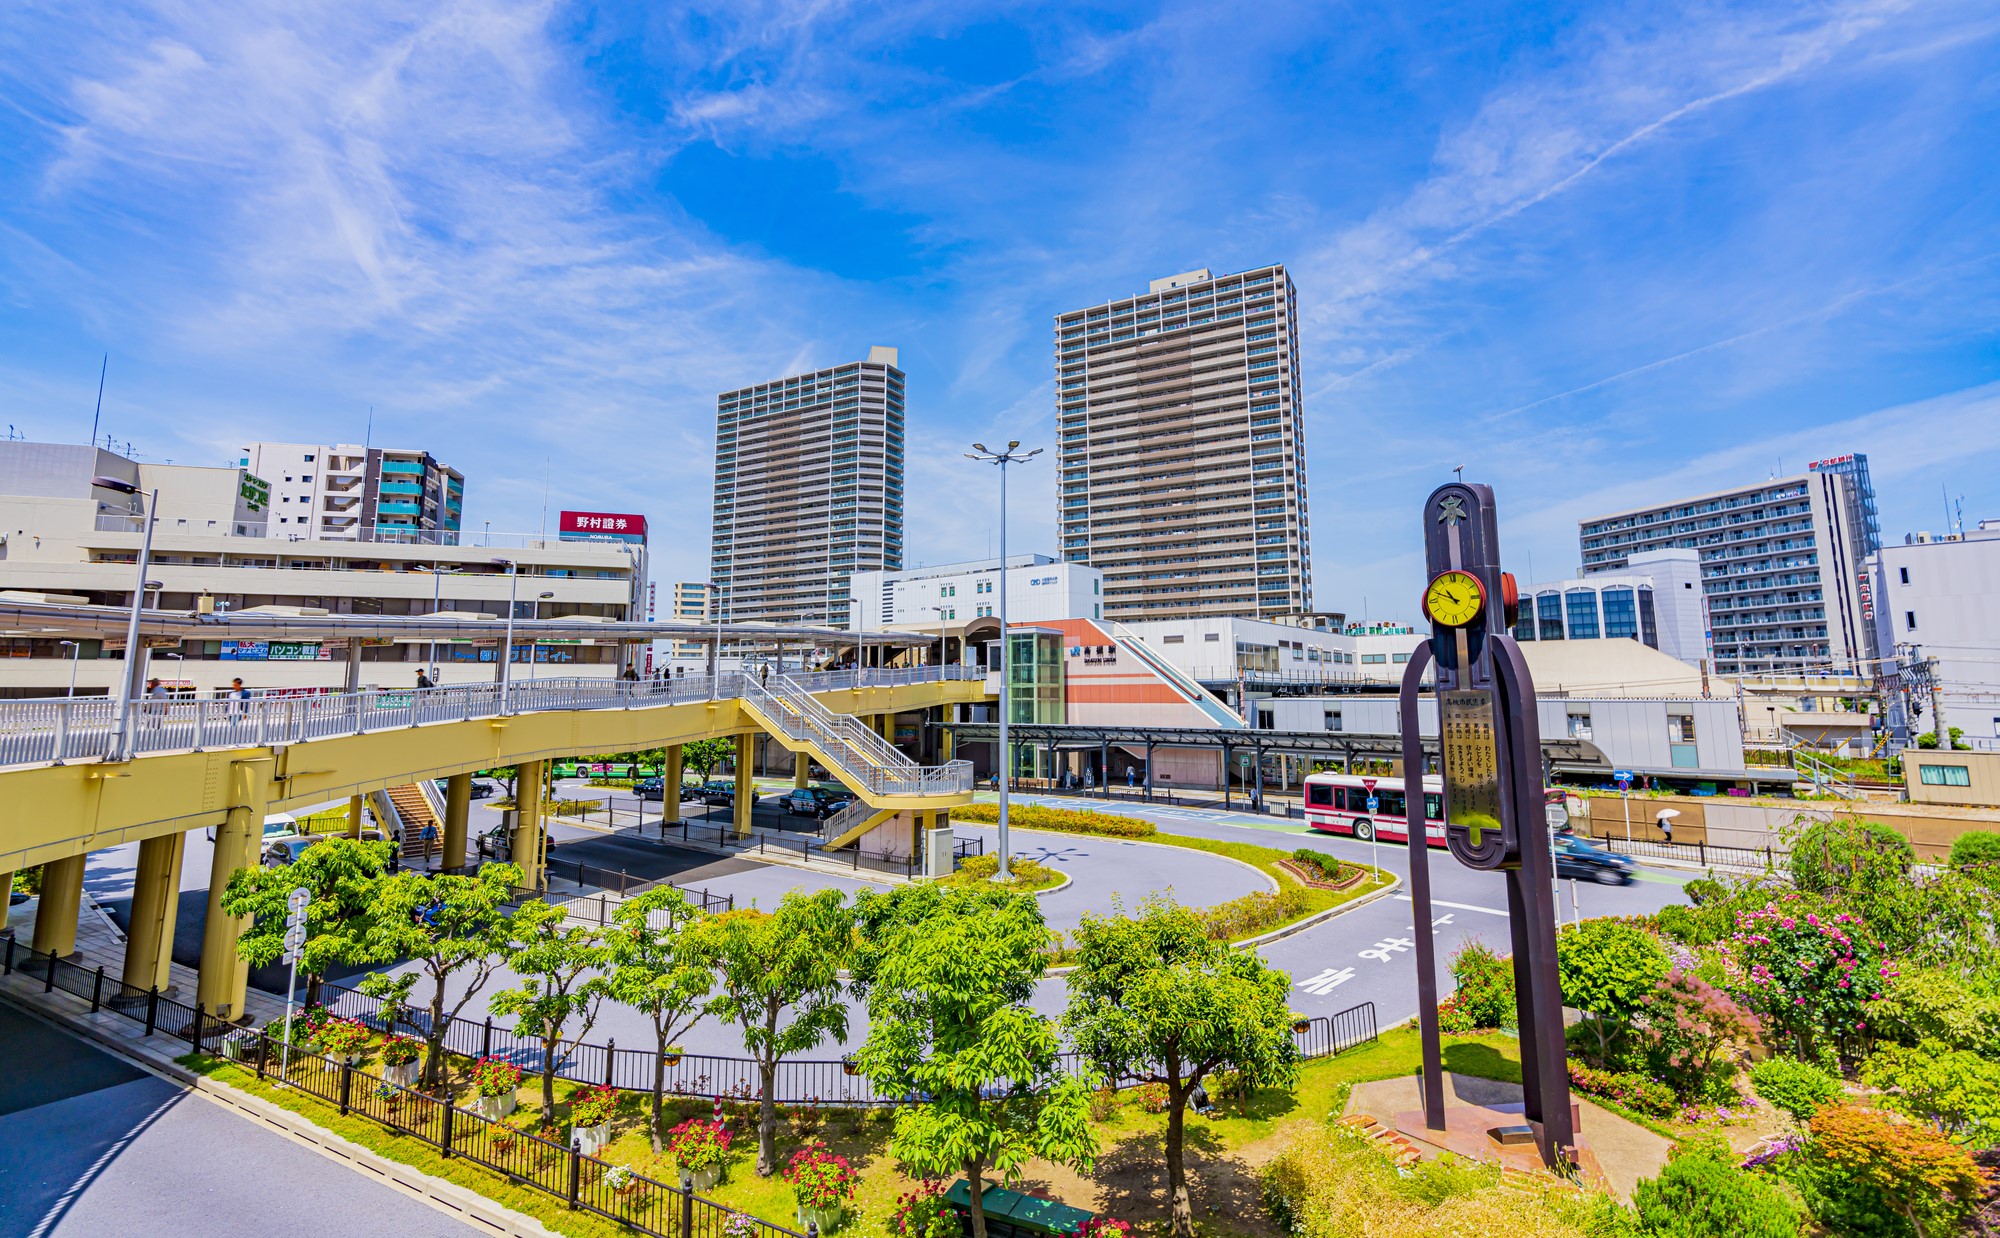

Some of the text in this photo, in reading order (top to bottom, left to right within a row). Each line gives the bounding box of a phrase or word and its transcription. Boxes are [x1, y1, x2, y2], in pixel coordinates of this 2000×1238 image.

[576, 516, 628, 530] 野村證券
[239, 640, 255, 648] 私大
[1069, 645, 1081, 657] JR
